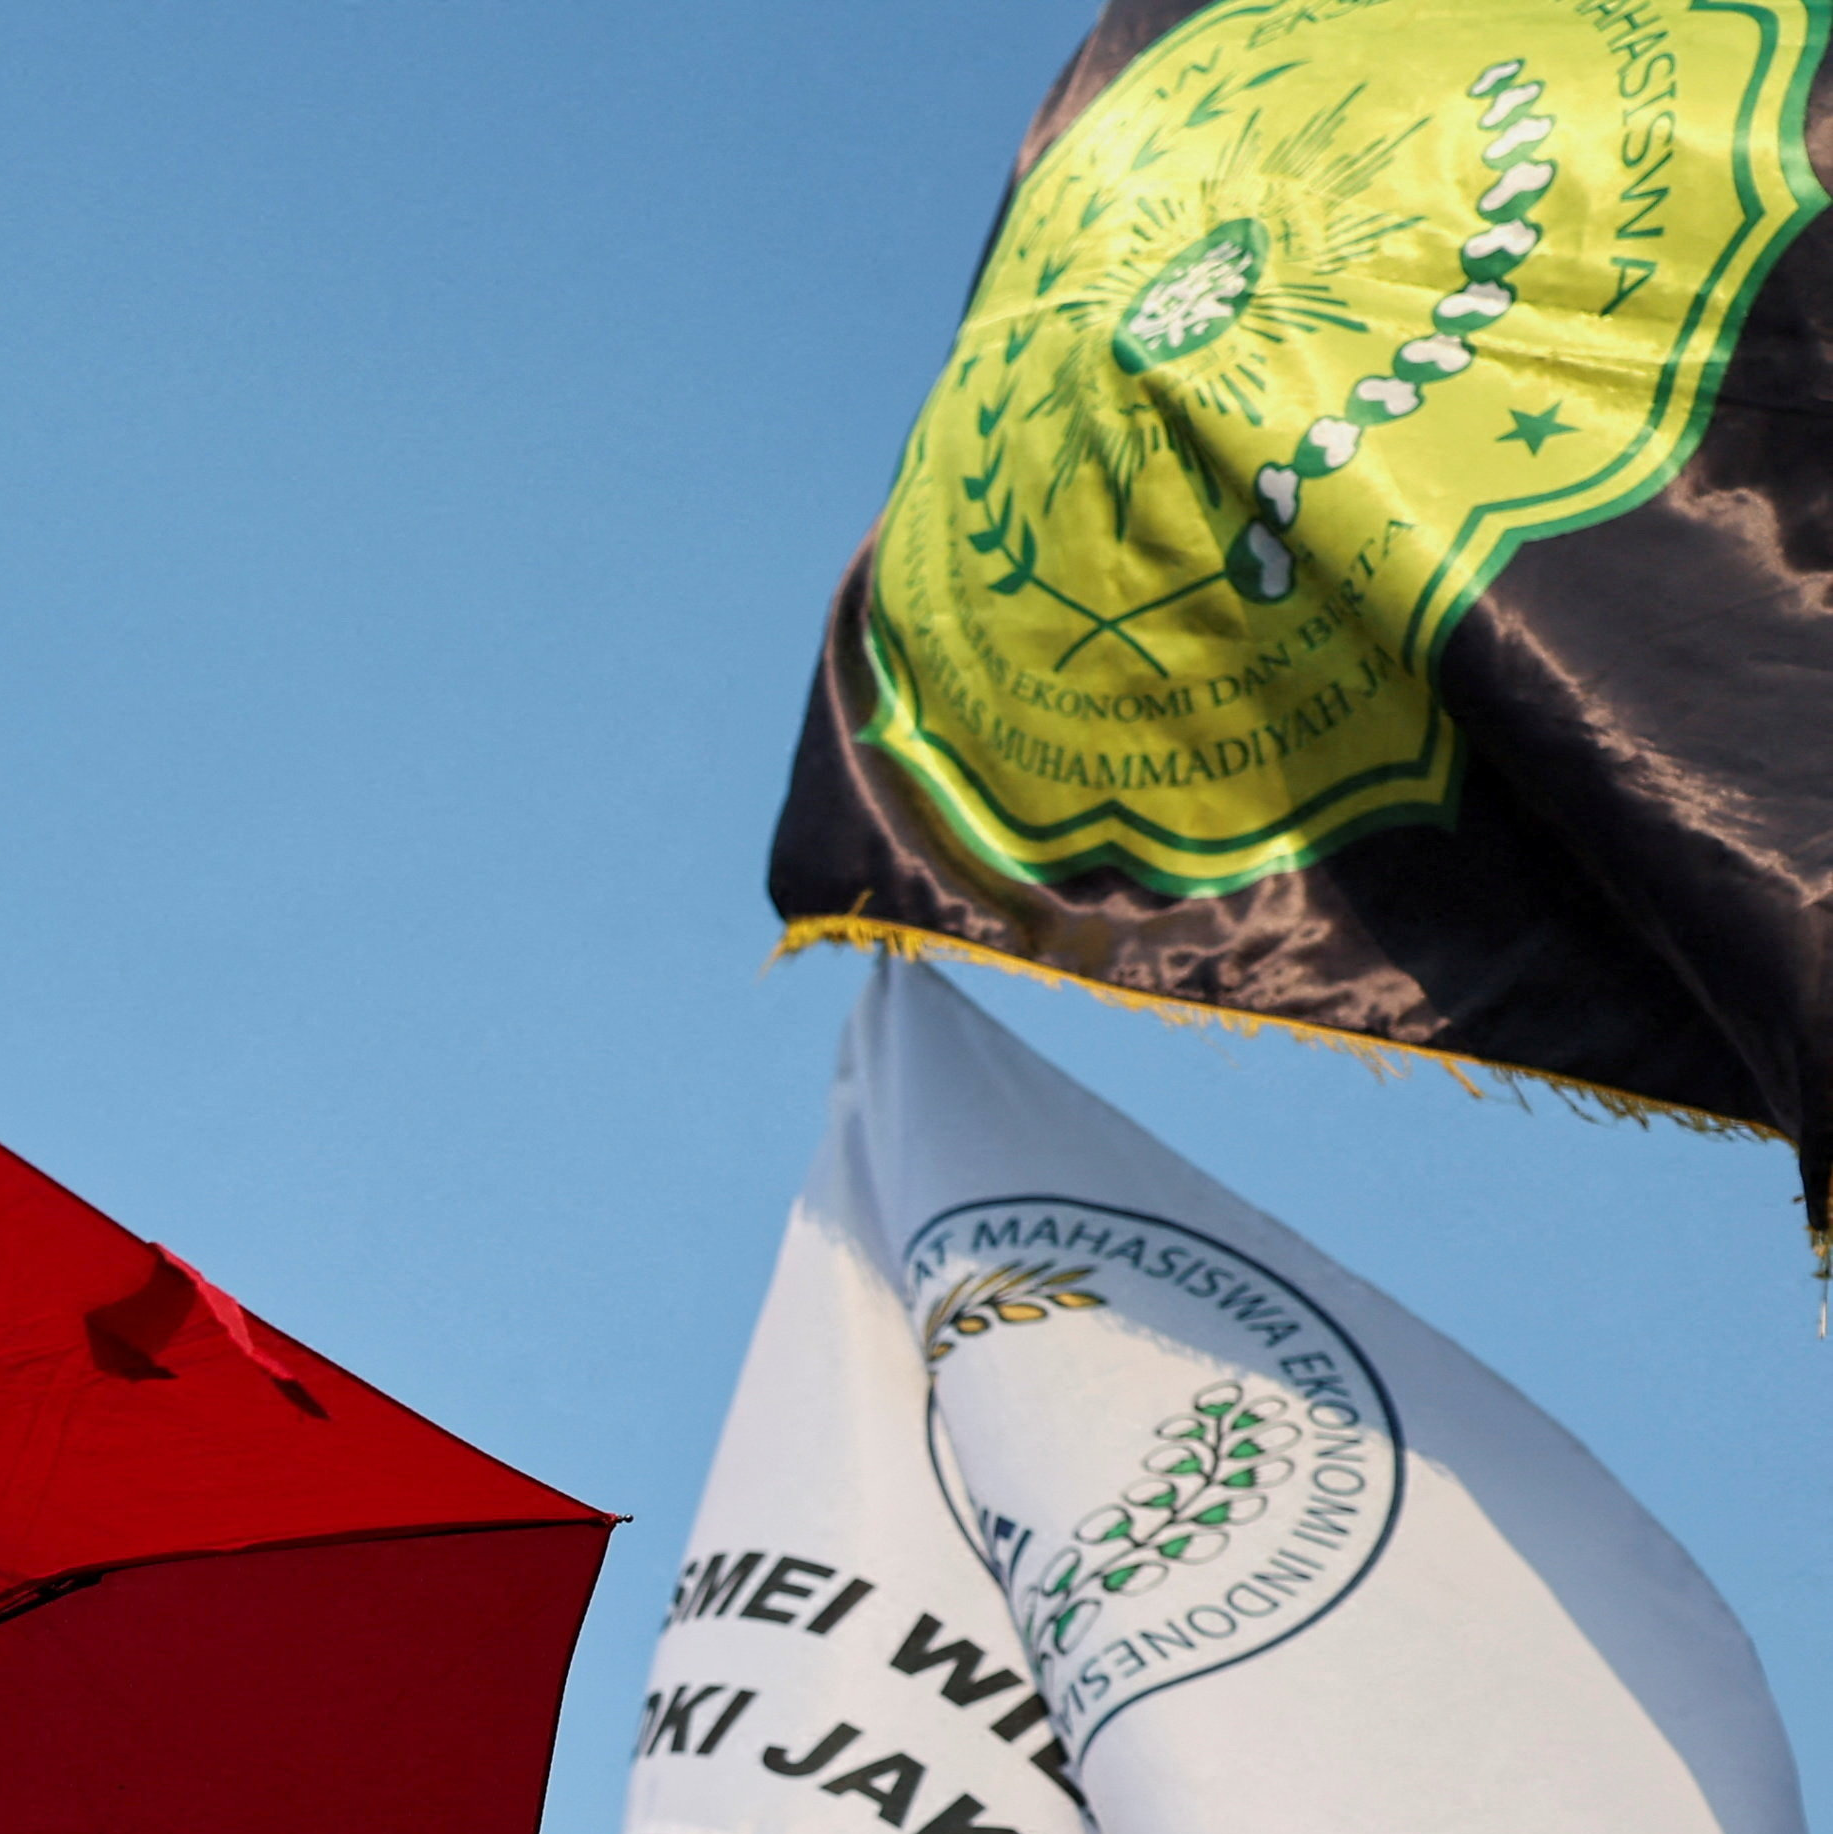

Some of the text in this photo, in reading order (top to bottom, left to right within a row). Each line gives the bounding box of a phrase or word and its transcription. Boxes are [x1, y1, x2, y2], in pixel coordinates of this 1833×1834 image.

[1011, 671, 1193, 724] EKONOMI
[1208, 641, 1291, 708] DAN
[970, 1216, 1299, 1348] MAHASISWA
[1281, 1351, 1365, 1549] EKONOMI
